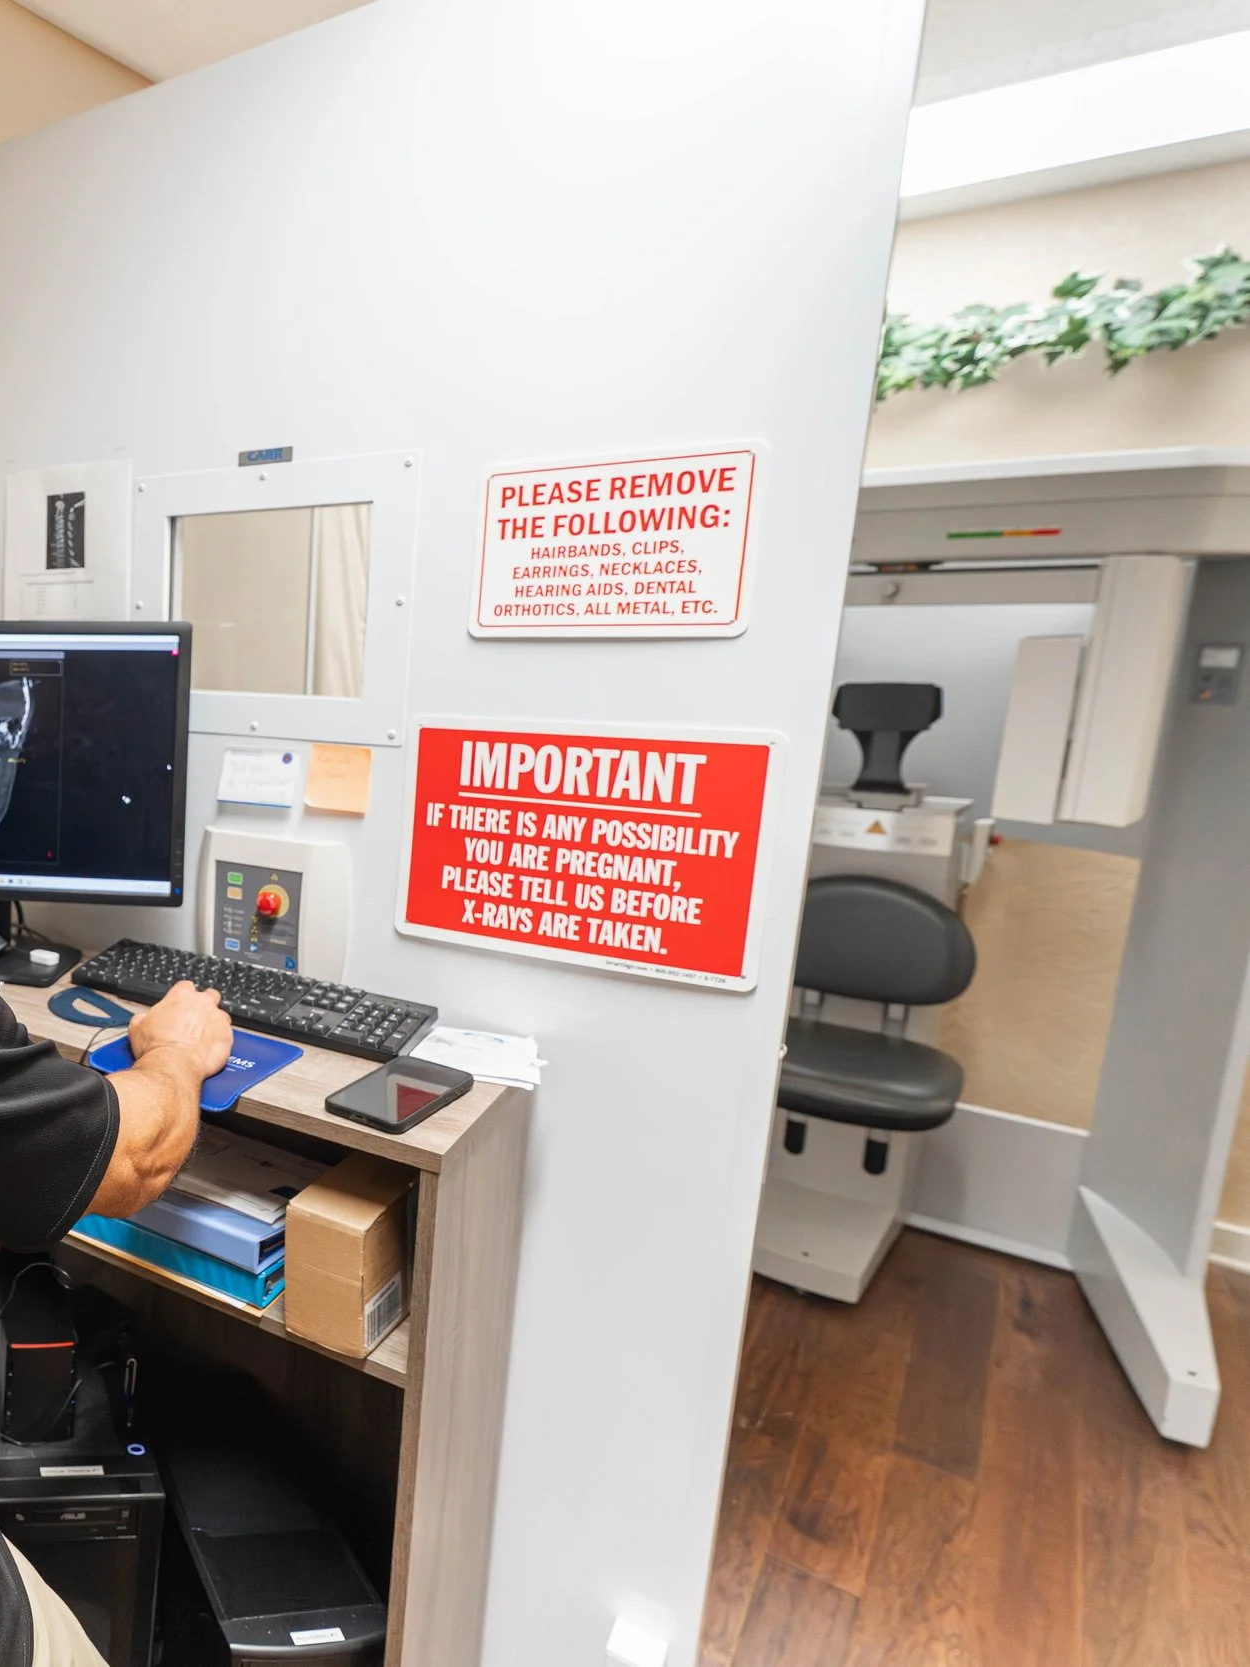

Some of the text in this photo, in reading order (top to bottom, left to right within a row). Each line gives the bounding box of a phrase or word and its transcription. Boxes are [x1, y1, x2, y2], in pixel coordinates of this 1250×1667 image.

[501, 467, 737, 509] PLEASE REMOVE
[498, 504, 731, 540] THE FOLLOWING:
[512, 560, 703, 580] EARRINGS, NECKLACES,
[531, 540, 685, 560] HAIRBANDS, CLIPS,
[494, 601, 718, 619] ORTHOTICS, ALL METAL, ETC.
[515, 580, 697, 598] HEARING AIDS, DENTAL
[460, 740, 707, 805] IMPORTANT
[427, 802, 740, 859] IF THERE IS ANY POSSIBILITY
[464, 837, 682, 892] YOU ARE PREGNANT,
[442, 866, 704, 925] PLEASE TELL US BEFORE
[462, 899, 668, 955] X-RAYS ARE TAKEN.
